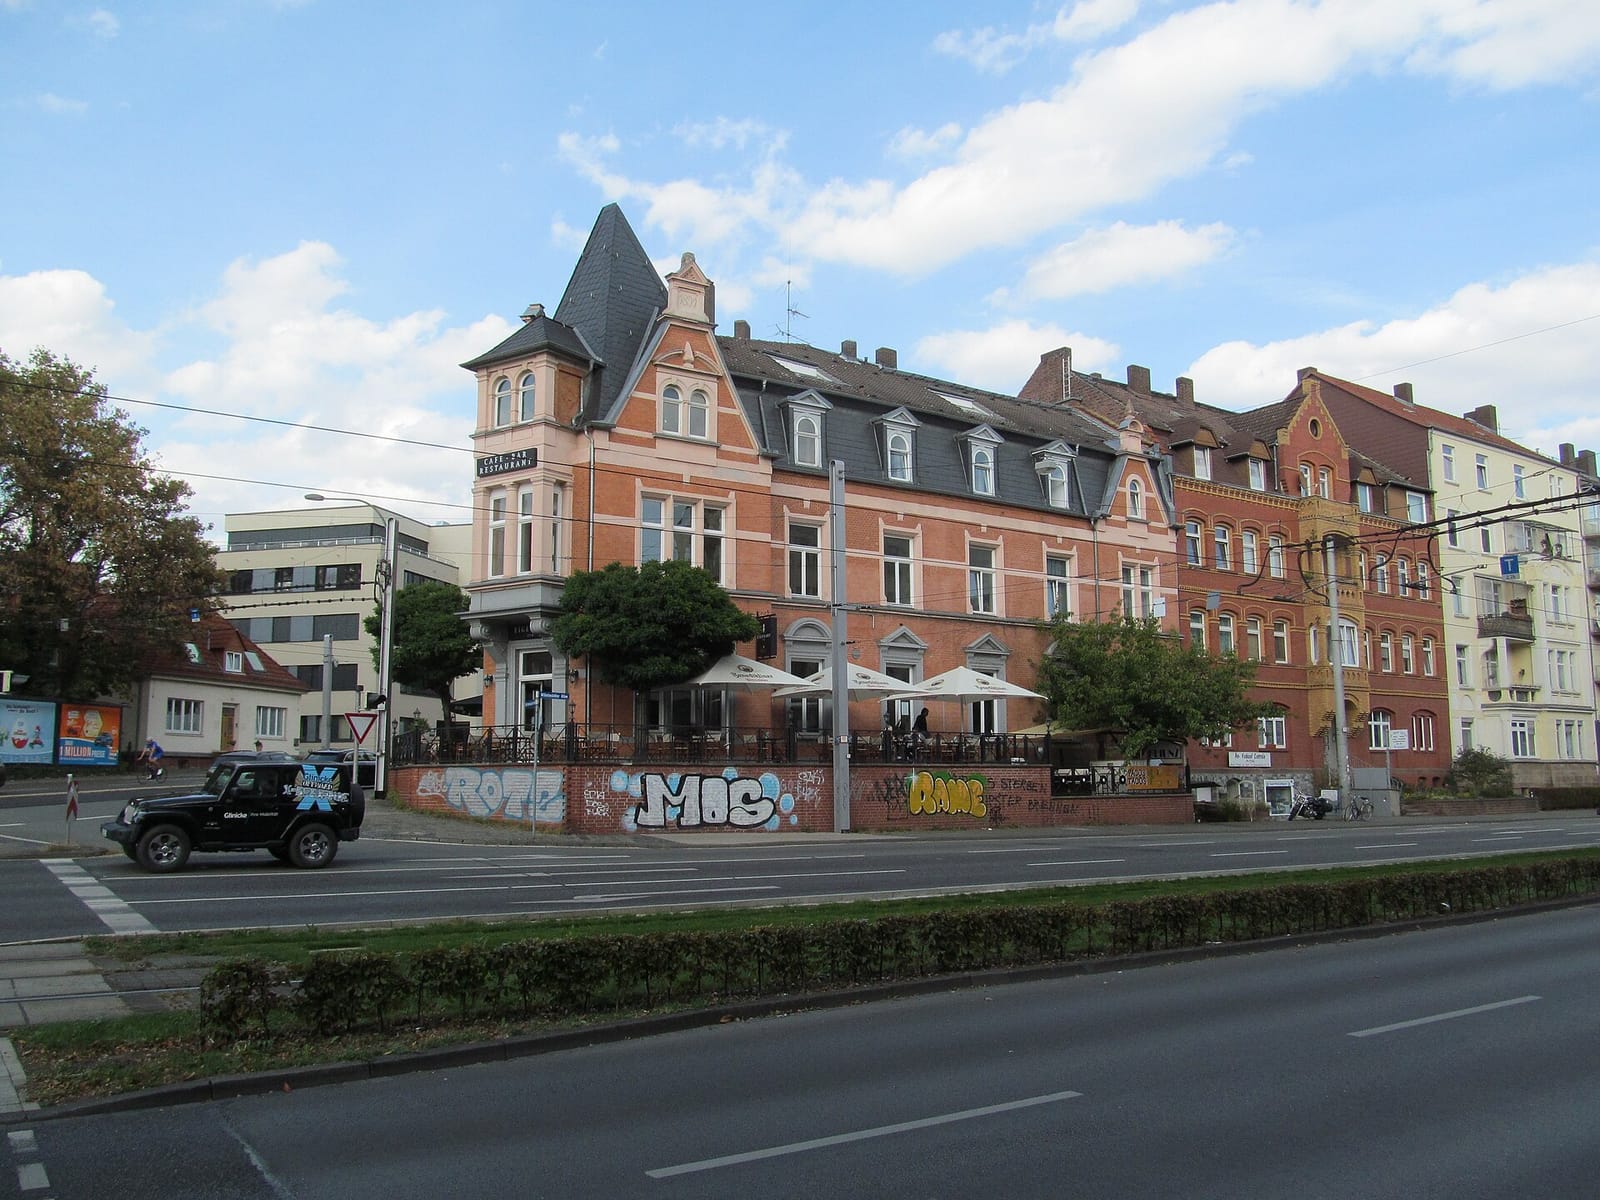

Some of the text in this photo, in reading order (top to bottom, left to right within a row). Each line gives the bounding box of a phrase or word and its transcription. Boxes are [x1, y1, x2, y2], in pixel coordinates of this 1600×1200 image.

[480, 458, 531, 474] RESTAURANT
[484, 456, 503, 466] CAFE
[634, 772, 776, 829] MOS
